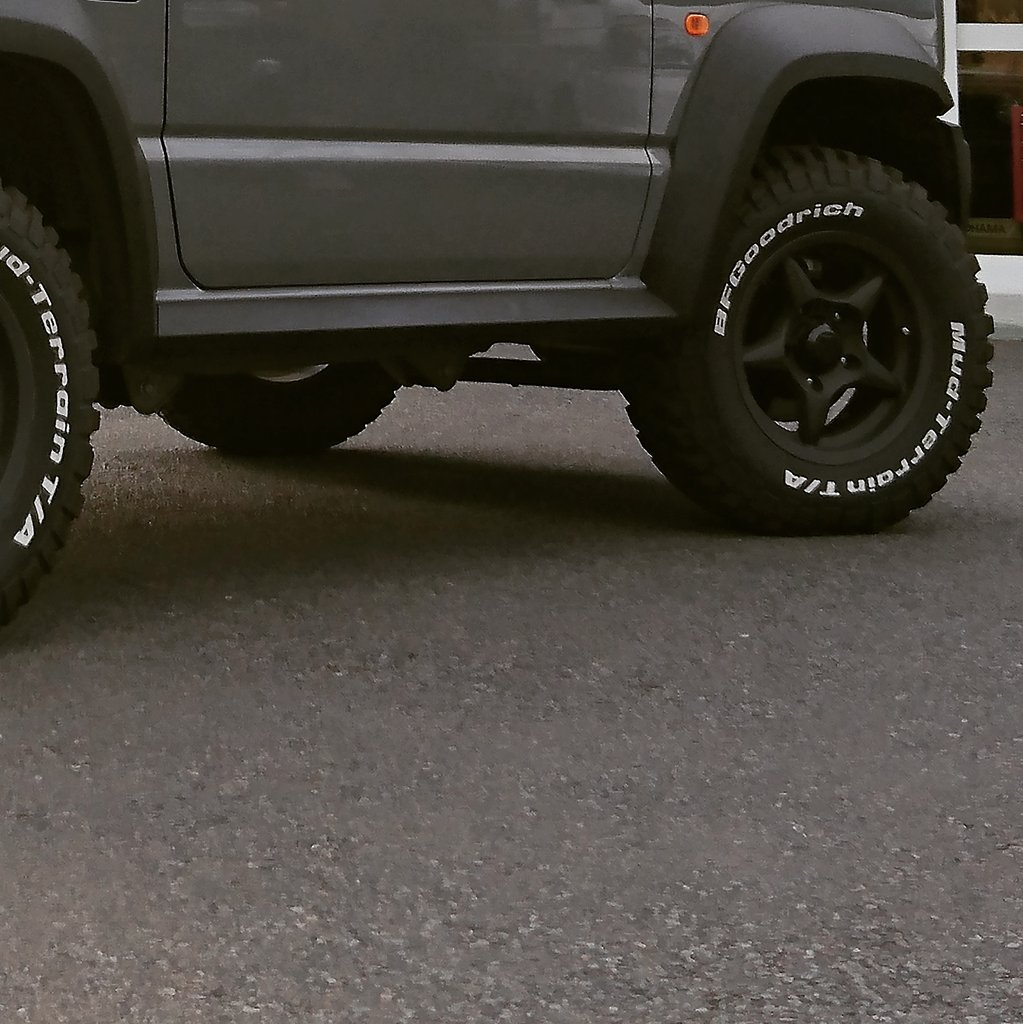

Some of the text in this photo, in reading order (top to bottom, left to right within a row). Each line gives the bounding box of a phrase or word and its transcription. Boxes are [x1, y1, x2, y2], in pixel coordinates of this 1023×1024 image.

[713, 202, 865, 337] BFGoodrich
[784, 321, 966, 496] Mud-Terrain T/A
[12, 474, 59, 548] T/A
